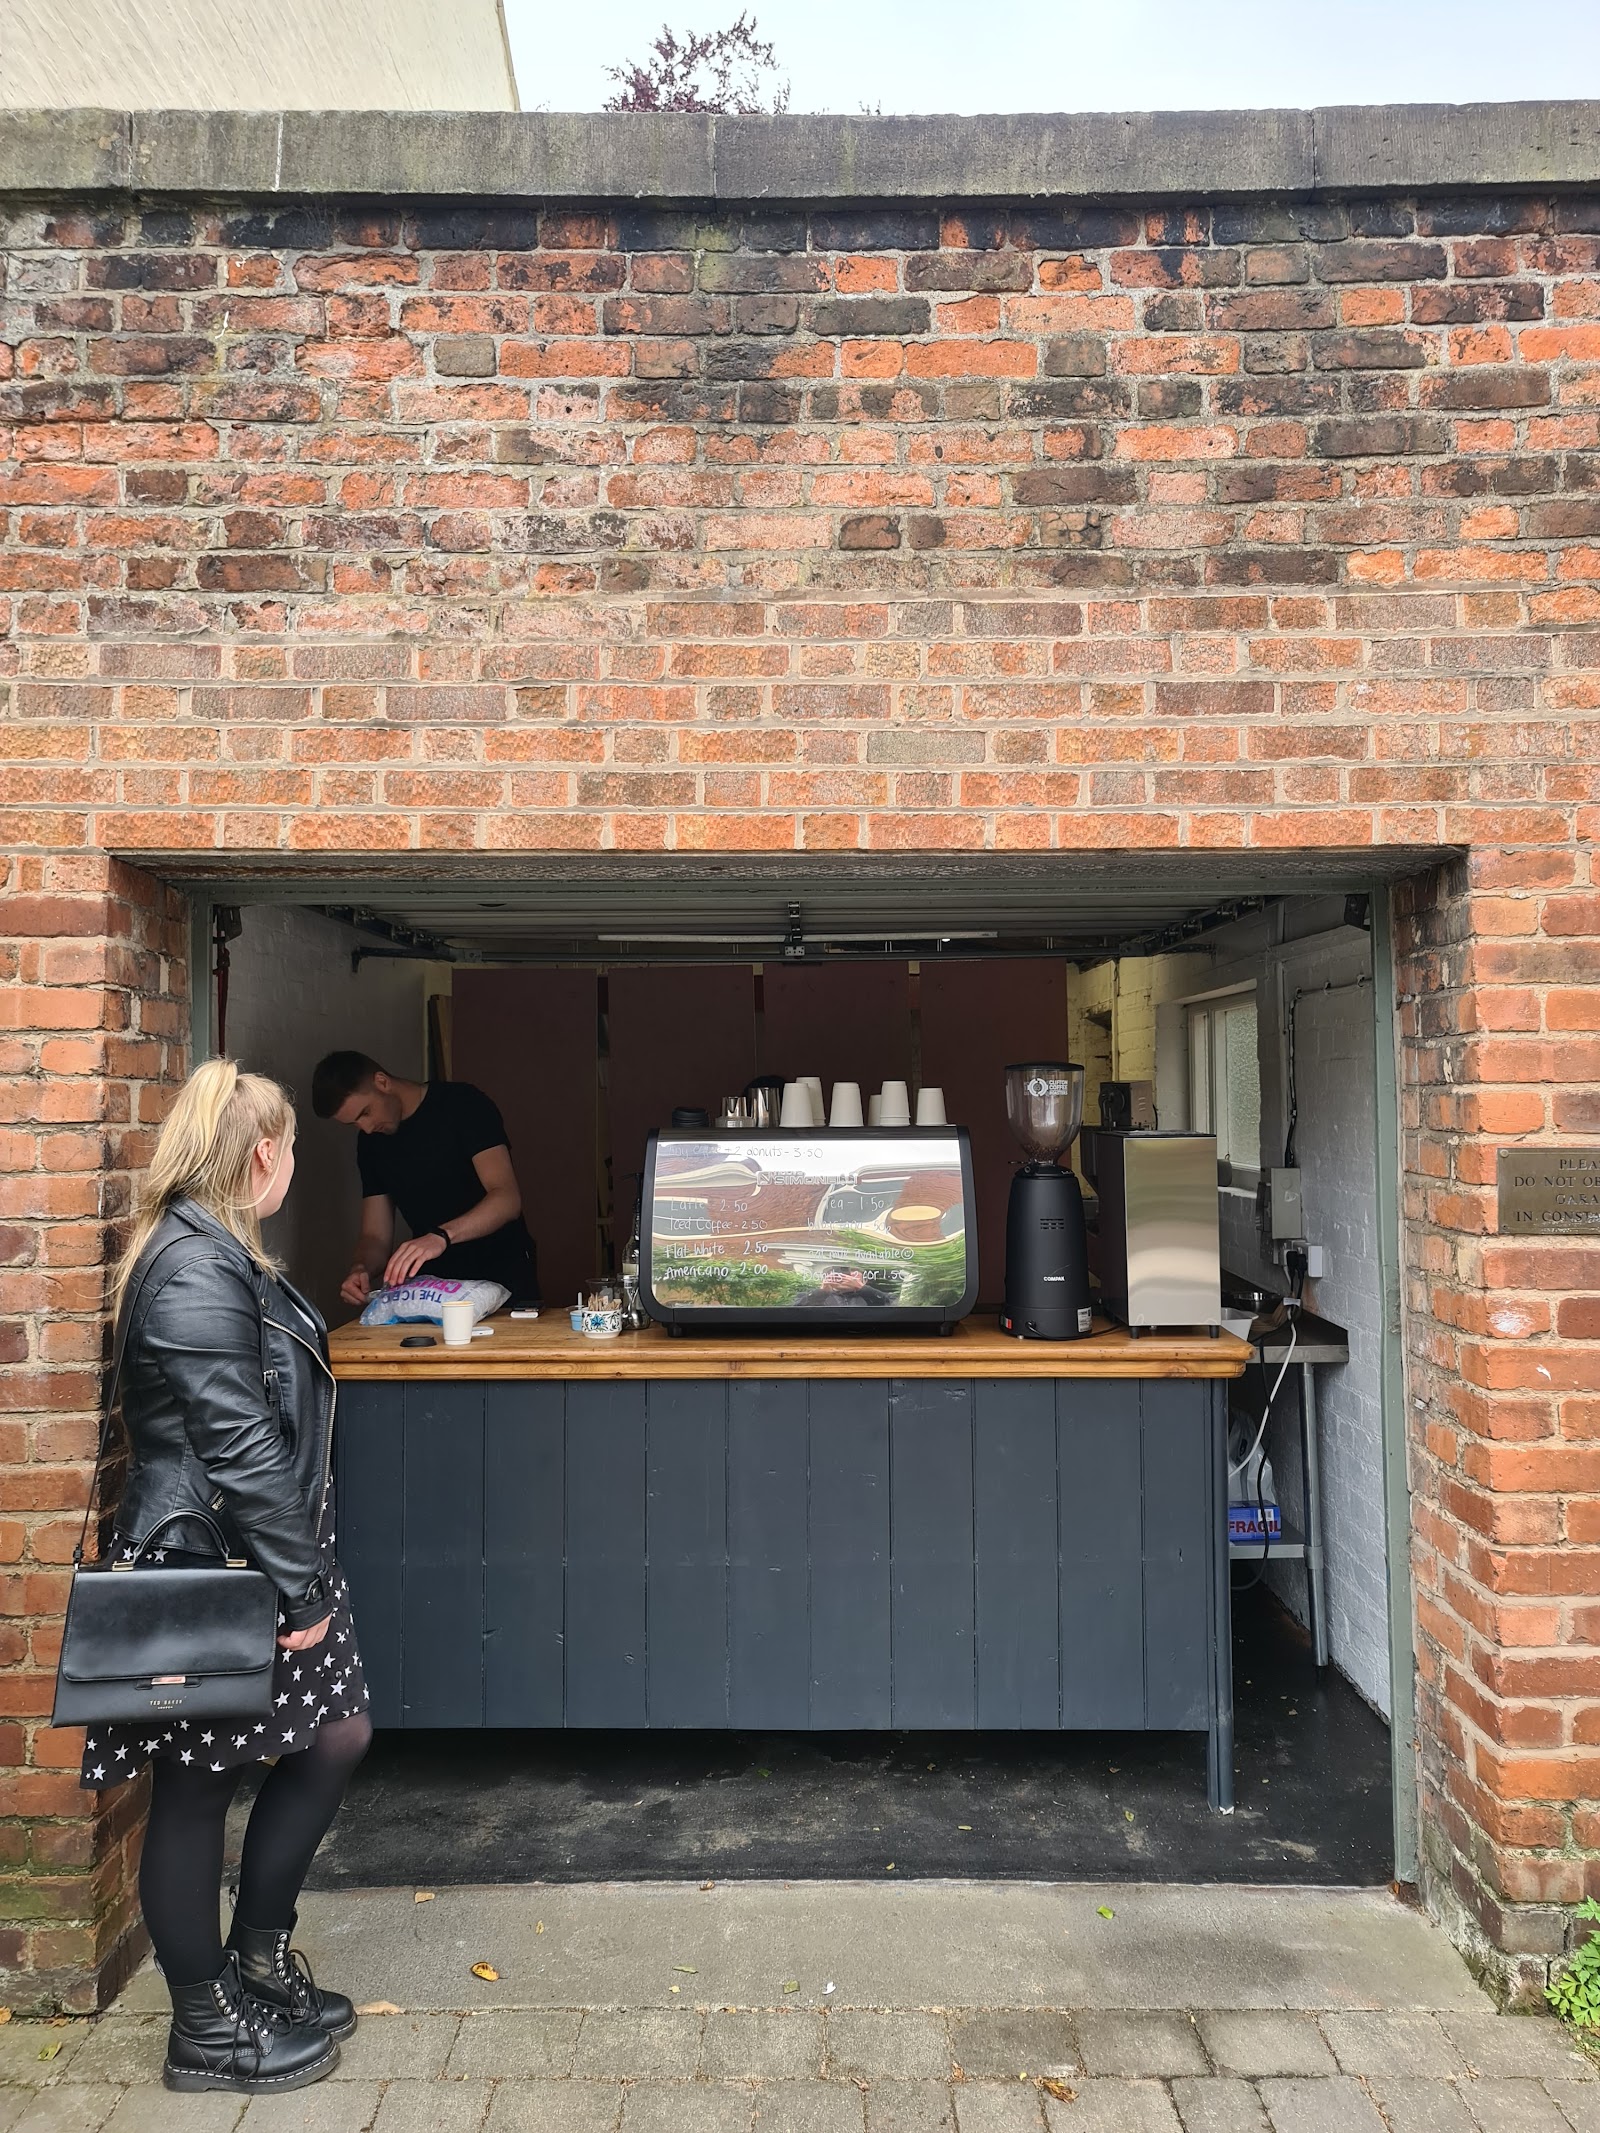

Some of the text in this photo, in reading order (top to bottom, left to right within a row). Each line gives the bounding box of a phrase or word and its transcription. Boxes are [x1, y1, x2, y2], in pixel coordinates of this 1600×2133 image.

[733, 1145, 742, 1155] 2
[746, 1145, 782, 1157] donuts
[793, 1147, 823, 1158] 3.50
[1560, 1159, 1600, 1169] PLEA
[774, 1176, 858, 1185] SIMONELLI
[1515, 1177, 1535, 1187] DO
[1544, 1177, 1576, 1187] NOT
[671, 1198, 705, 1211] Latte
[720, 1199, 748, 1212] 2.50
[823, 1197, 844, 1210] Tea
[860, 1197, 884, 1211] 1.50
[1516, 1211, 1533, 1222] IN
[670, 1216, 691, 1230] Iced
[696, 1217, 733, 1233] Coffee
[741, 1220, 768, 1229] 2.50
[664, 1243, 688, 1258] Flat
[694, 1241, 725, 1254] White
[743, 1240, 768, 1255] 2.50
[855, 1247, 901, 1259] available
[664, 1265, 728, 1279] Americano
[740, 1262, 768, 1275] 2.00
[803, 1268, 842, 1282] Donuts
[862, 1269, 878, 1284] for
[393, 1289, 415, 1301] ICE
[419, 1289, 442, 1304] THE
